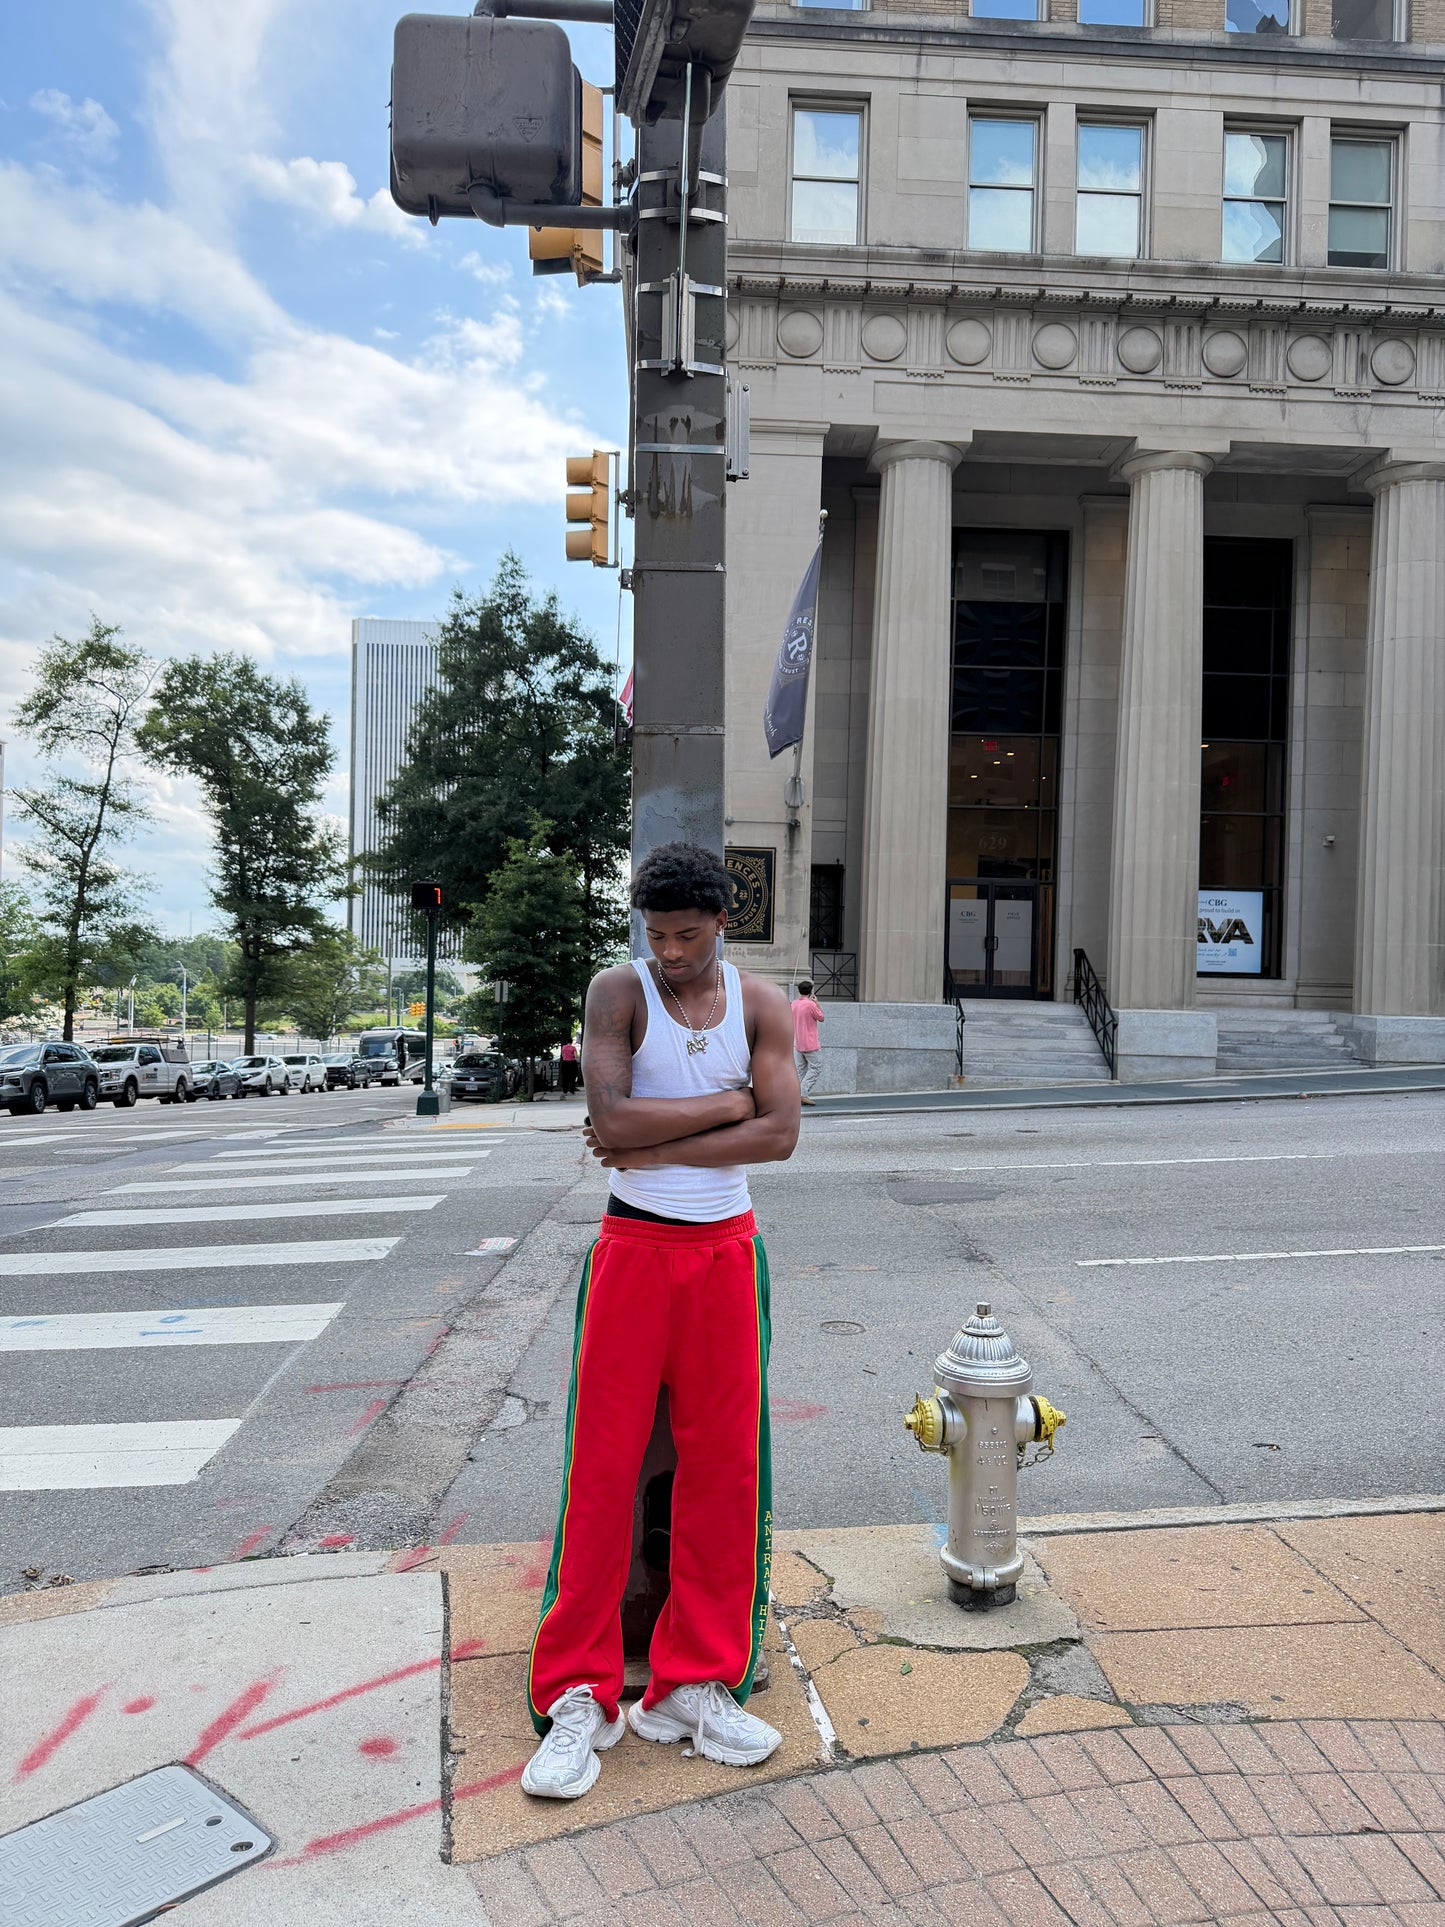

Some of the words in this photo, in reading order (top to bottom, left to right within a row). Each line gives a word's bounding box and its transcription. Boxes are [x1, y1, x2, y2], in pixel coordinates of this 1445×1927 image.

[787, 631, 808, 660] R
[979, 835, 1007, 850] 629
[740, 903, 759, 924] TRUST
[1208, 899, 1228, 907] CBG
[763, 1510, 773, 1592] ANIRAV
